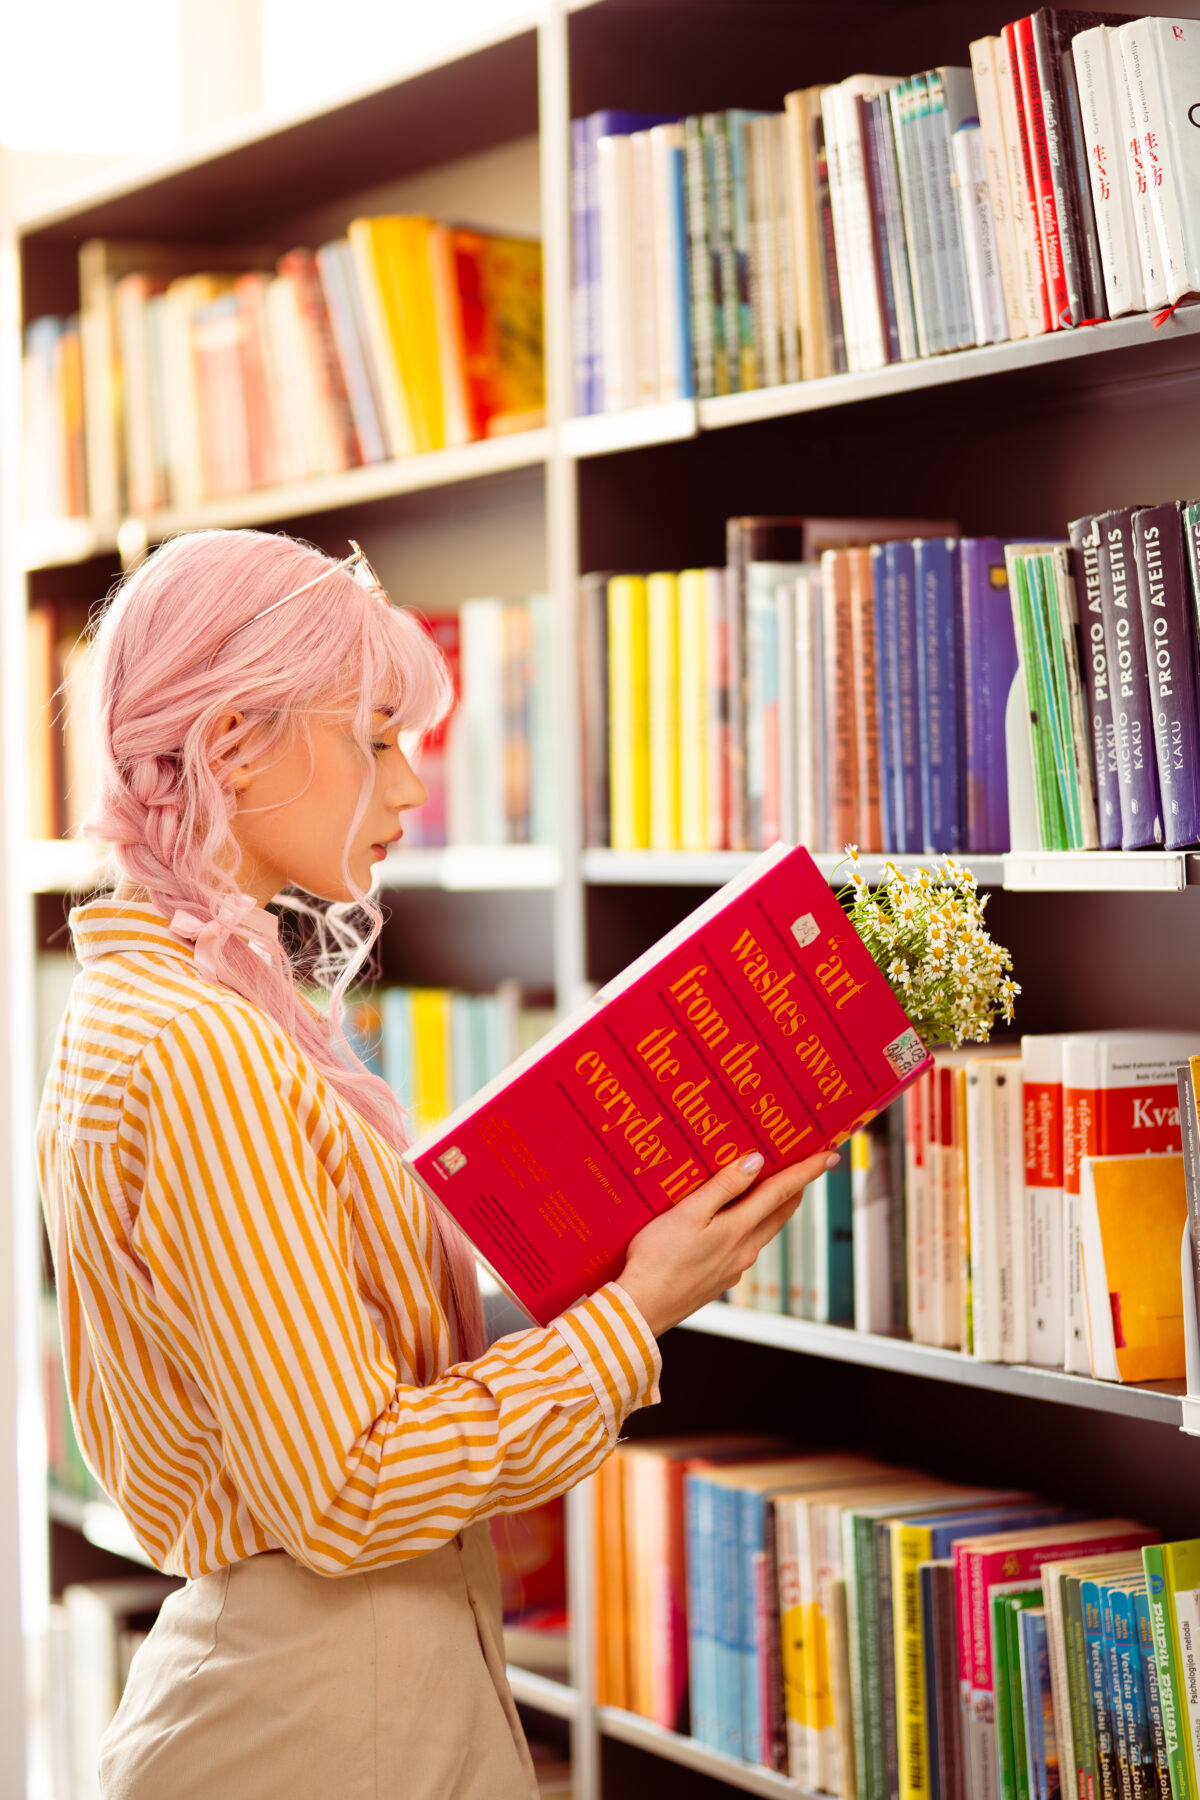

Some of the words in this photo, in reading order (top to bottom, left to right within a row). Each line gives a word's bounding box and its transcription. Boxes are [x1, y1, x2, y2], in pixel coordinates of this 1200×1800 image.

[1129, 39, 1141, 78] filosofija
[1137, 79, 1150, 122] Gyvenimo
[1040, 194, 1056, 233] Lewis
[1045, 235, 1062, 279] Howes
[1082, 534, 1102, 614] ATEITIS
[1108, 528, 1128, 609] ATEITIS
[1144, 526, 1166, 608] ATEITIS
[1090, 622, 1108, 701] PROTO
[1116, 618, 1134, 698] PROTO
[1152, 617, 1173, 698] PROTO
[1118, 712, 1132, 784] MICHIO
[1131, 720, 1144, 770] KAKU
[1157, 712, 1172, 784] MICHIO
[1170, 720, 1184, 770] KAKU
[732, 929, 805, 1035] washes
[796, 1035, 851, 1109] away
[637, 1029, 679, 1080] the
[672, 1079, 728, 1145] dust
[670, 966, 729, 1049] from
[720, 1043, 760, 1094] the
[751, 1094, 812, 1154] soul
[575, 1051, 672, 1176] everyday
[1091, 1641, 1104, 1688] Verčiau
[1152, 1601, 1170, 1667] mama
[1180, 1620, 1193, 1651] metodai
[1121, 1652, 1133, 1698] Verčiau
[1183, 1653, 1200, 1704] Psichologijos
[1094, 1690, 1106, 1730] geriau
[1124, 1702, 1136, 1742] geriau
[1150, 1705, 1164, 1745] geriau
[1158, 1672, 1180, 1753] Vieniša
